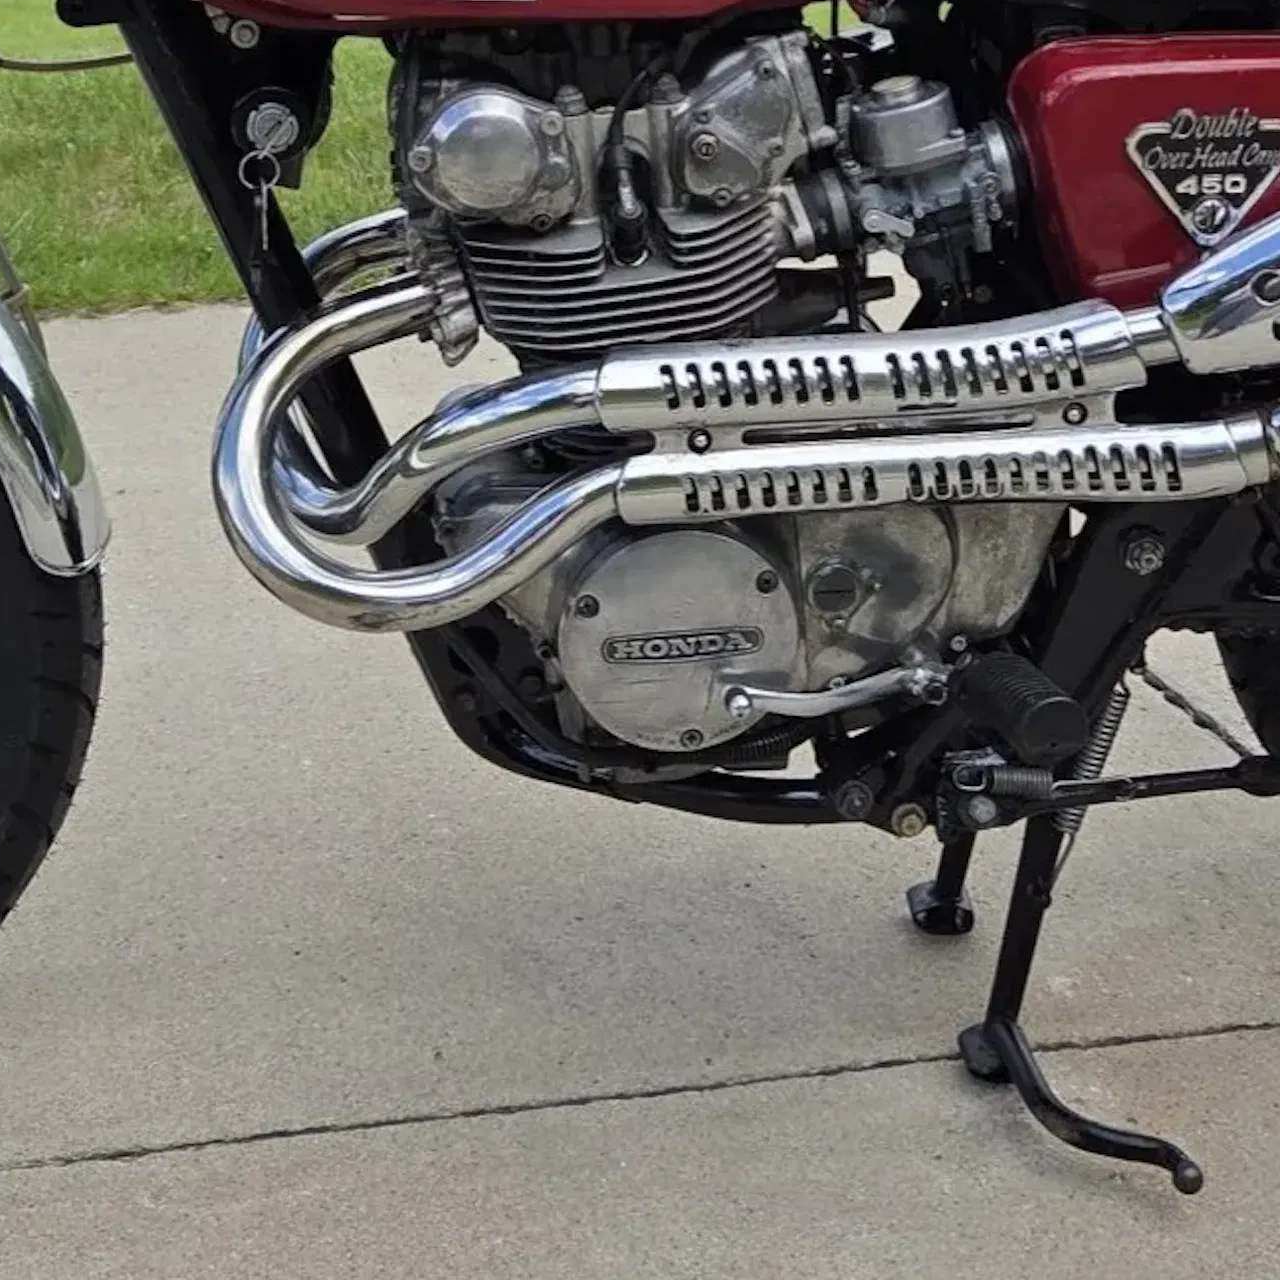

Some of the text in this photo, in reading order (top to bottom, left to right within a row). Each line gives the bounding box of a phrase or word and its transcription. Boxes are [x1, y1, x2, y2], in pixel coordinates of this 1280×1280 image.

[1170, 107, 1258, 140] Double
[1142, 144, 1190, 170] Over
[1187, 141, 1244, 169] Head
[1175, 173, 1248, 196] 450
[611, 632, 753, 660] HONDA
